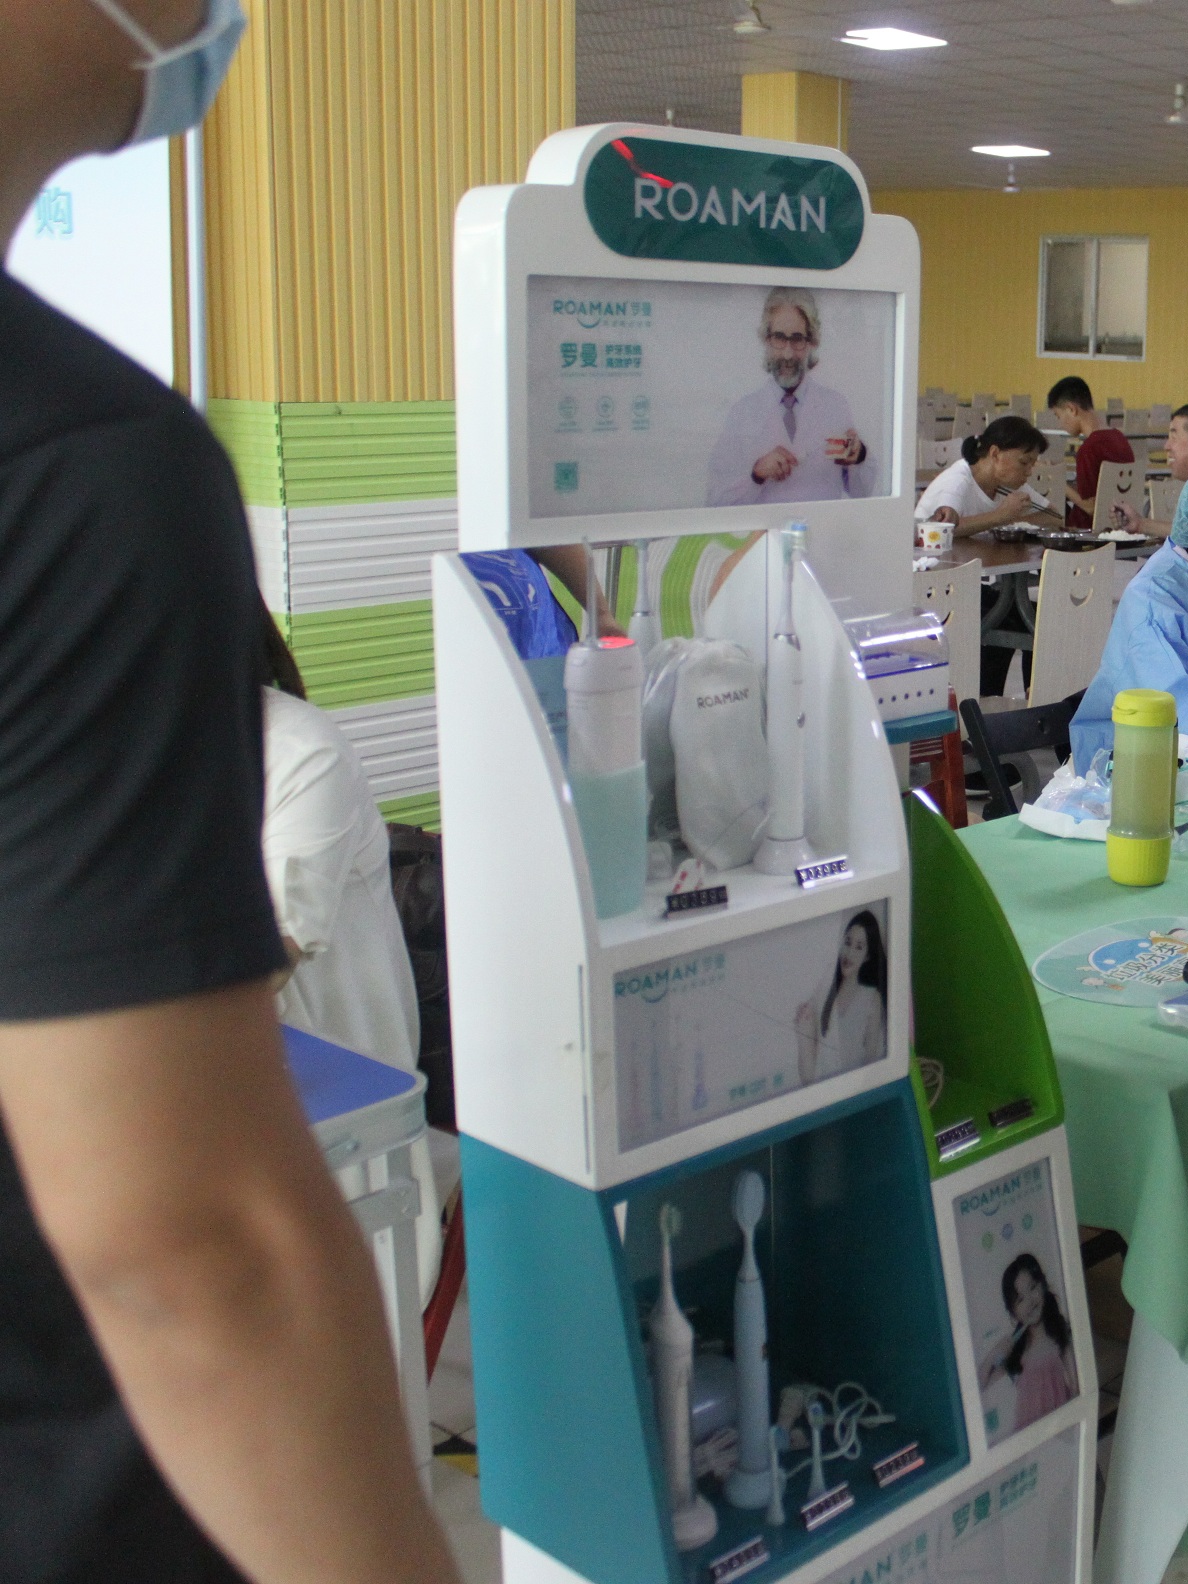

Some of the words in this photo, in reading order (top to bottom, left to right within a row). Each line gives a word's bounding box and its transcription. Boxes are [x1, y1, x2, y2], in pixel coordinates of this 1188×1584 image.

[633, 177, 828, 235] ROAMAN
[553, 299, 627, 316] ROAMAN
[560, 342, 598, 368] 罗曼
[697, 688, 749, 709] ROAMAN
[614, 961, 698, 998] ROAMAN
[1104, 942, 1183, 980] 垃圾分类
[960, 1176, 1021, 1215] ROAMAN
